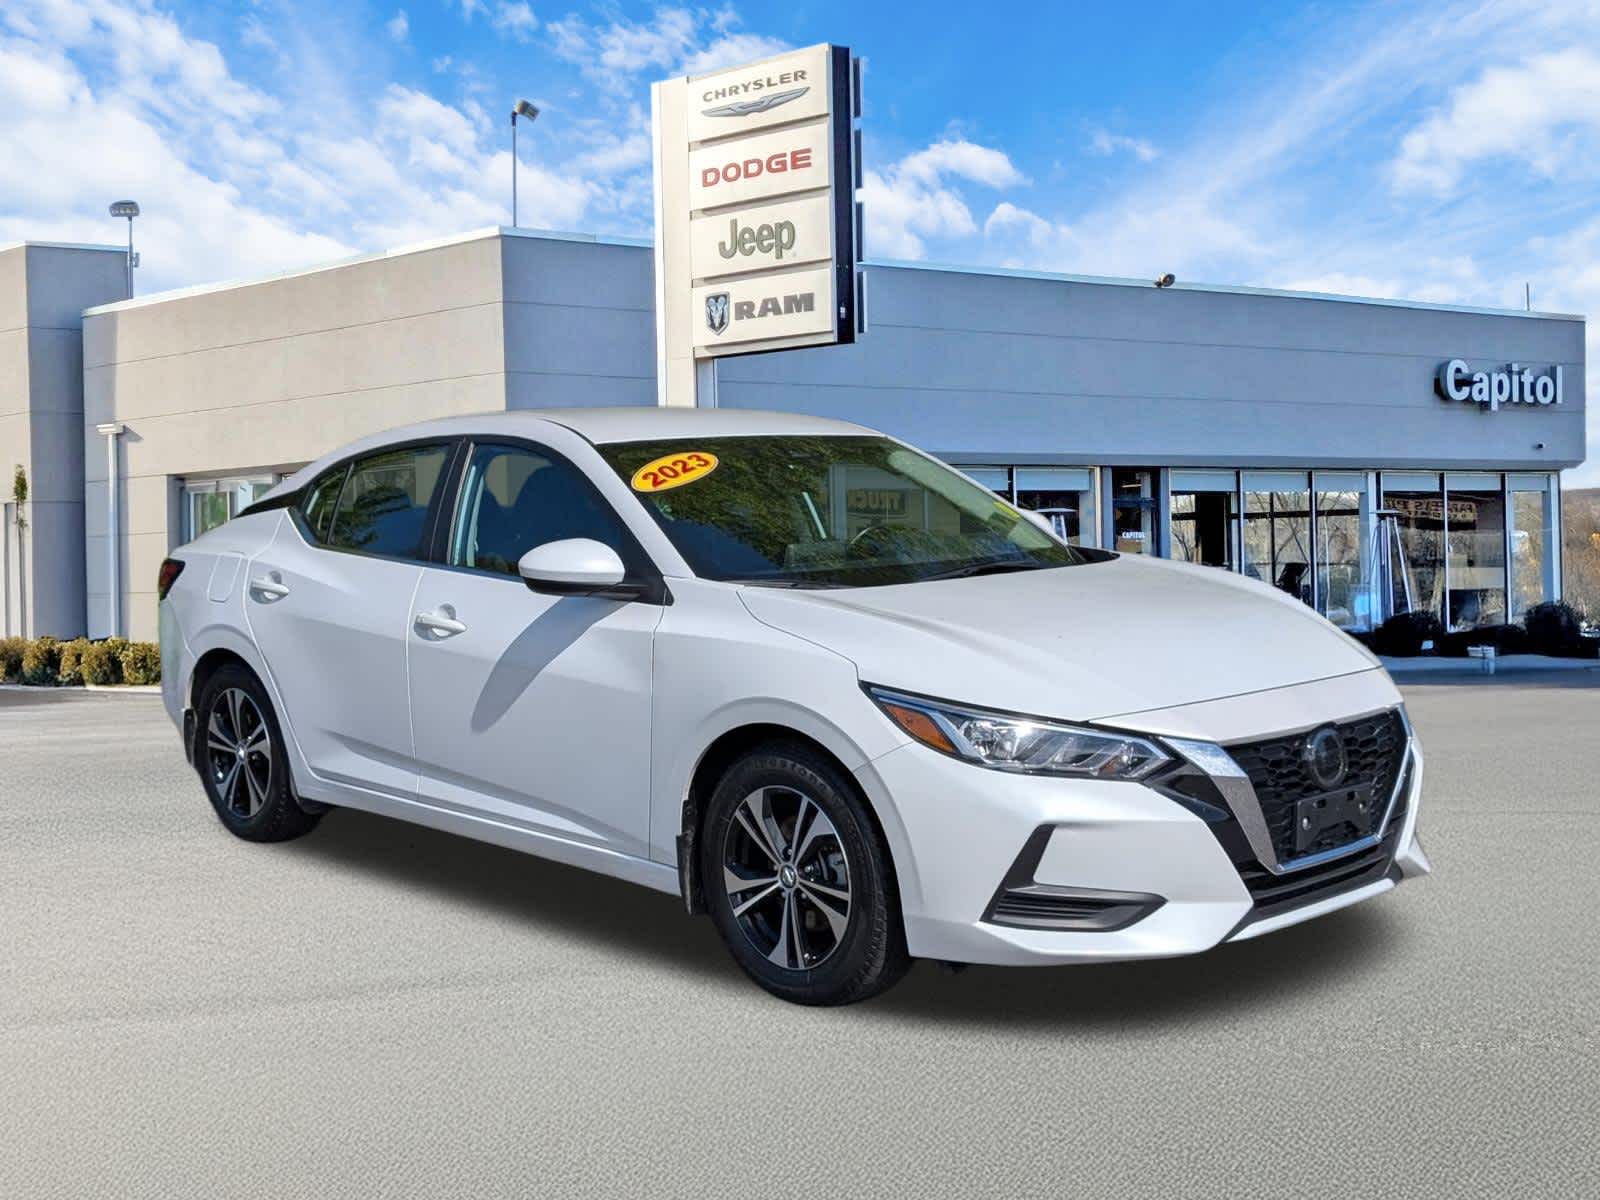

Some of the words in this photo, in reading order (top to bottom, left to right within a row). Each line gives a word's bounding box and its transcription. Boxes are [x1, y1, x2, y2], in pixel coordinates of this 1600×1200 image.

[702, 70, 808, 102] CHRYSLER
[702, 148, 812, 188] DODGE
[718, 219, 796, 259] Jeep
[734, 292, 816, 321] RAM
[1446, 359, 1563, 411] Capitol
[642, 454, 710, 488] 2023
